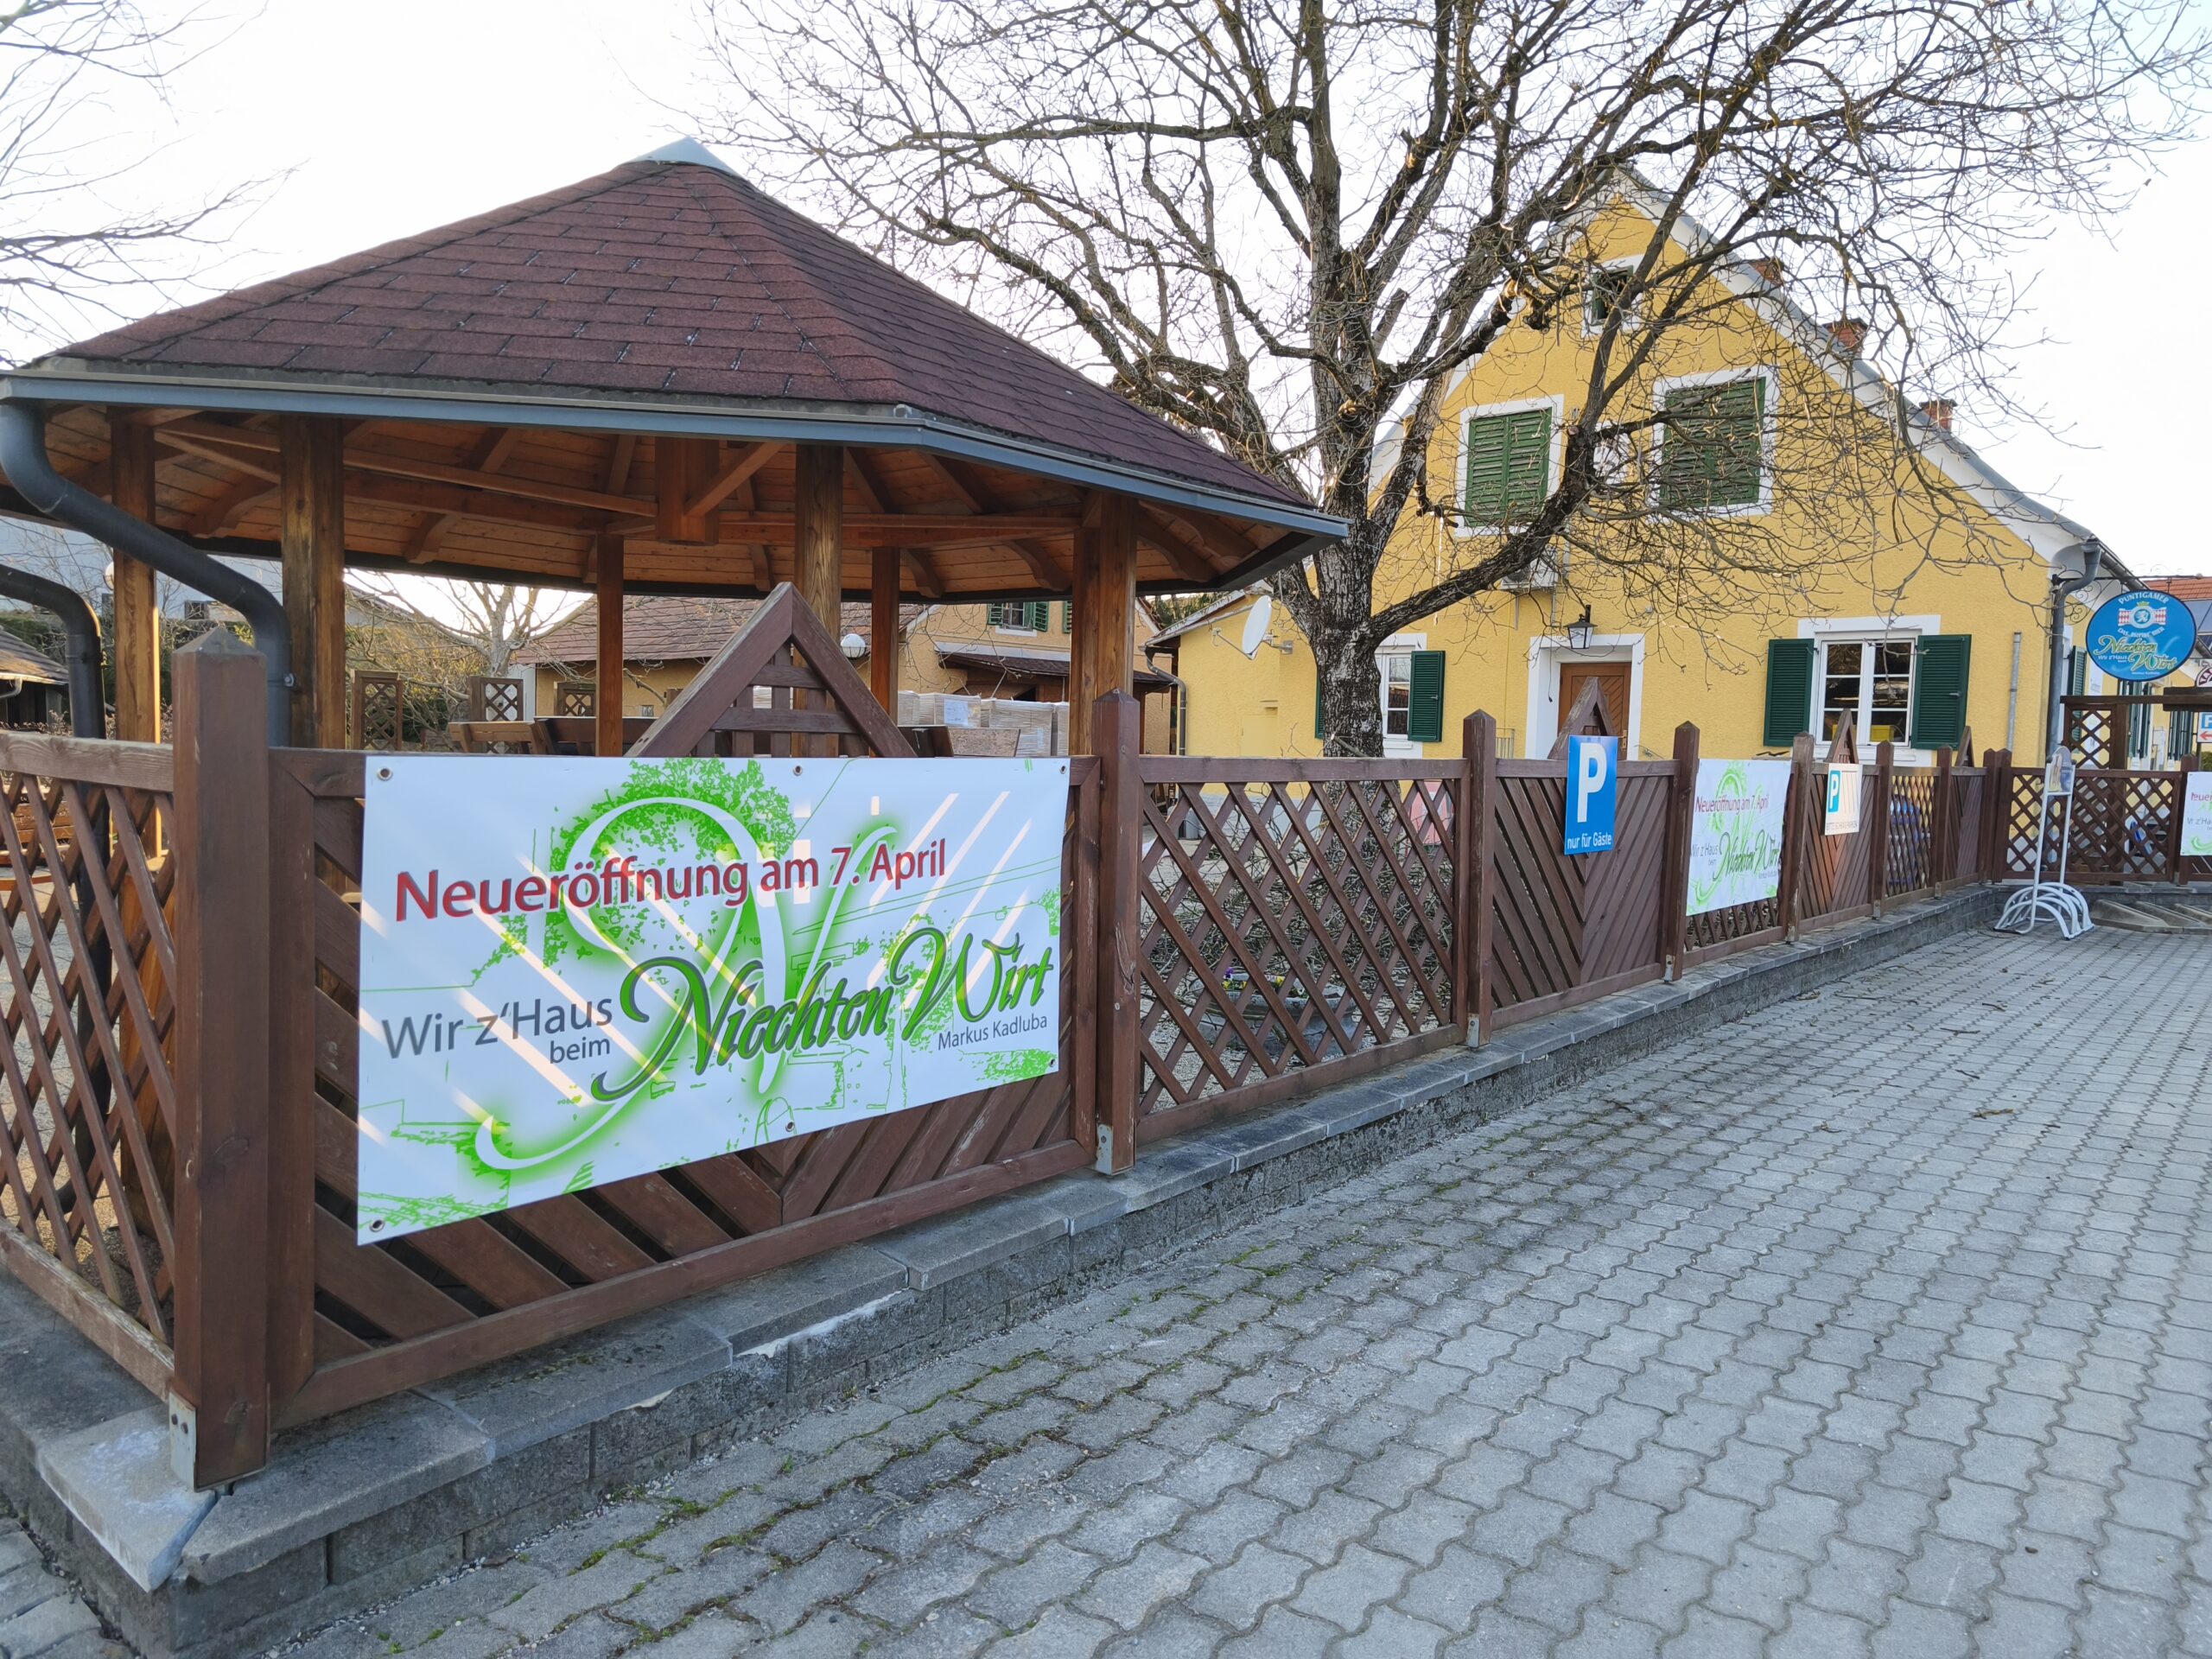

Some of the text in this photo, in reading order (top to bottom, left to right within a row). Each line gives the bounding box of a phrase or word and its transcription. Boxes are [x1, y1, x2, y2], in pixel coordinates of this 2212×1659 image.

[2118, 591, 2170, 605] PUNTIGAMER
[1577, 742, 1607, 823] P
[1829, 773, 1839, 809] P
[1694, 795, 1739, 815] Neueröffnung
[1741, 798, 1751, 810] am
[1757, 793, 1769, 813] April
[1567, 831, 1612, 849] nur für Gäste
[395, 838, 946, 922] Neueröffnung am 7. April
[591, 927, 1055, 1102] Niechten Wirt
[938, 1013, 1047, 1051] Markus Kadluba
[381, 1013, 463, 1058] Wir
[550, 1037, 611, 1064] beim
